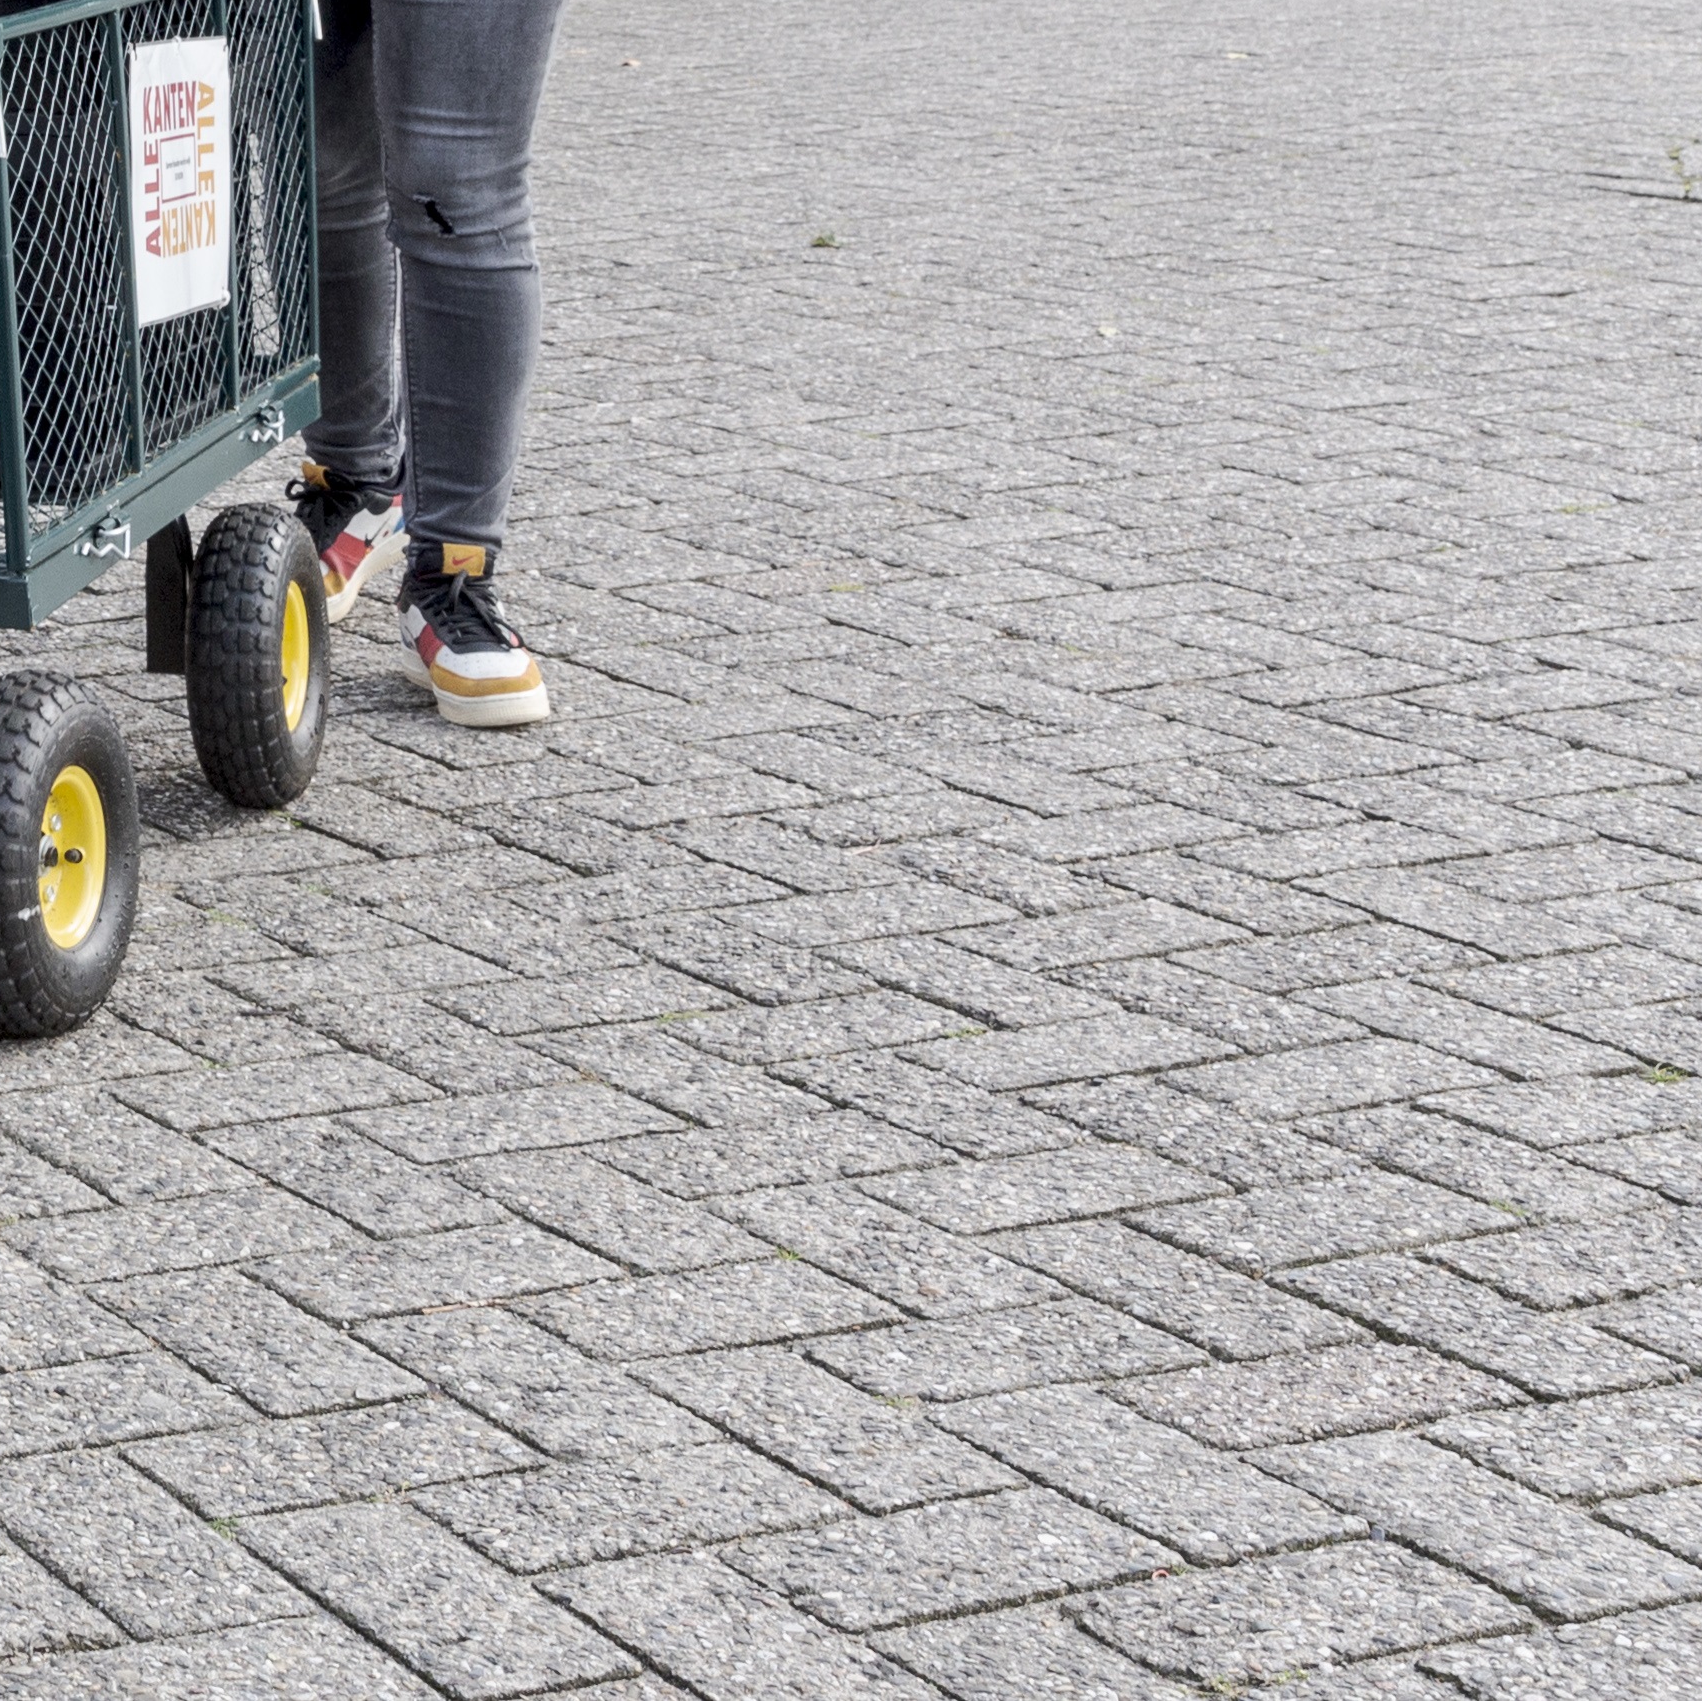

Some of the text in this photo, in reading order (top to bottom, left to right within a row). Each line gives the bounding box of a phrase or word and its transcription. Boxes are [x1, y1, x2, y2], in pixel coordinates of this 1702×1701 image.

[143, 81, 197, 135] KANTEN
[197, 81, 215, 196] ALLE
[144, 139, 161, 258] ALLE
[162, 200, 216, 258] KANTEN
